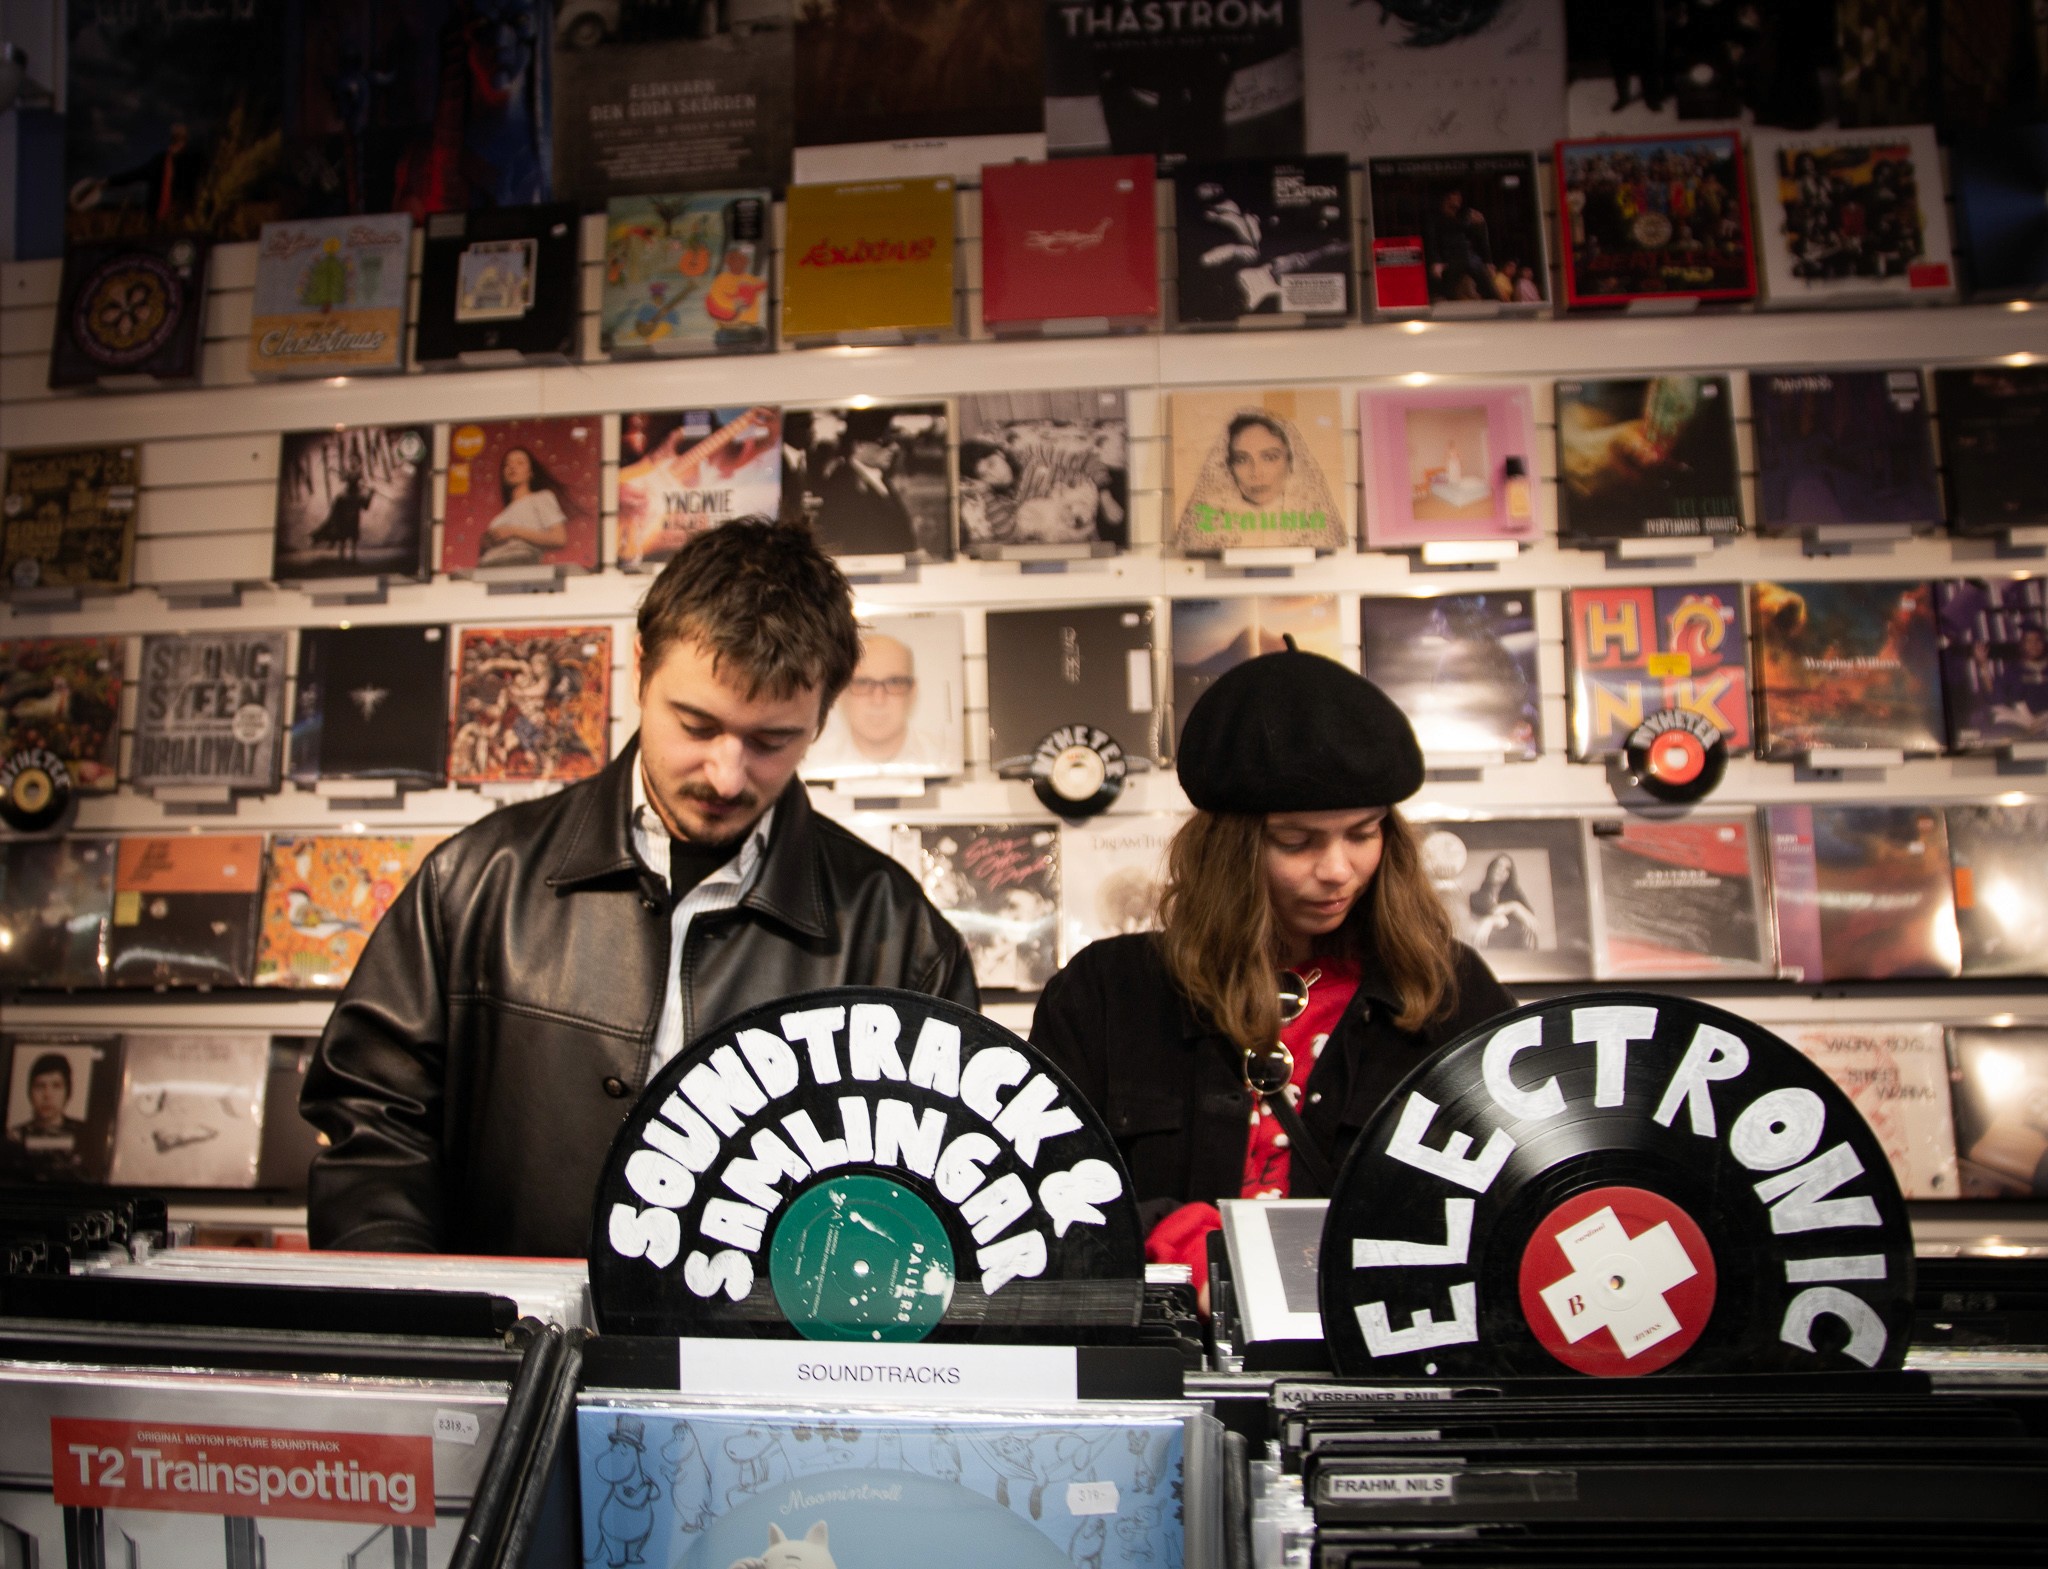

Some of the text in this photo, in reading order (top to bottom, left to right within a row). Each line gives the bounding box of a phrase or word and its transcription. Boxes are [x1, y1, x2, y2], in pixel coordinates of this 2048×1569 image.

[664, 488, 734, 514] YNGWIE
[1632, 709, 1721, 751] NYHETER
[609, 1003, 1123, 1269] SOUNDTRACK &
[684, 1096, 1048, 1302] SAMLINGAR
[1352, 1006, 1888, 1368] ELECTRONIC
[897, 1242, 925, 1323] PALLERS
[1567, 1294, 1585, 1317] B
[797, 1363, 961, 1385] SOUNDTRACKS
[136, 1430, 341, 1453] ORIGINAL MOTION PICTURE SOUNDTRACK
[68, 1443, 417, 1514] T2 Trainspotting
[1334, 1478, 1445, 1494] FRAHM, NILS
[779, 1483, 903, 1516] Moomintroll
